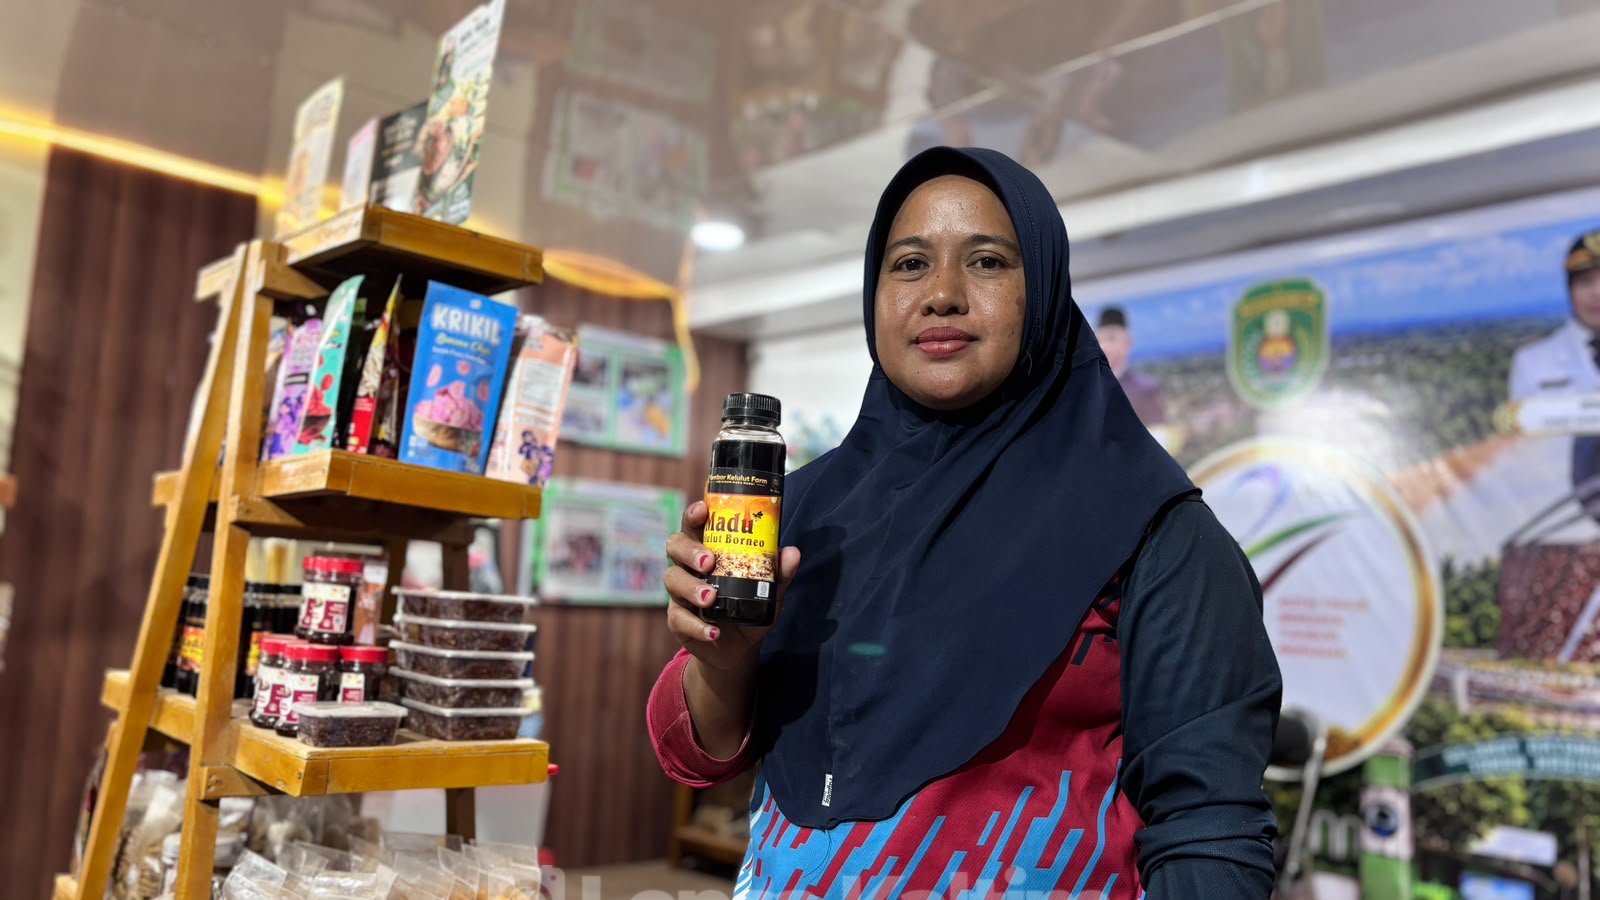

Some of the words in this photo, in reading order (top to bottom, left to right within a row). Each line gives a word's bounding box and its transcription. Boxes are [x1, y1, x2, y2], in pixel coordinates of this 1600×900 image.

[432, 303, 500, 346] KRIKIL
[727, 474, 750, 482] Kelulut
[751, 476, 768, 485] Farm
[725, 534, 765, 548] Borneo
